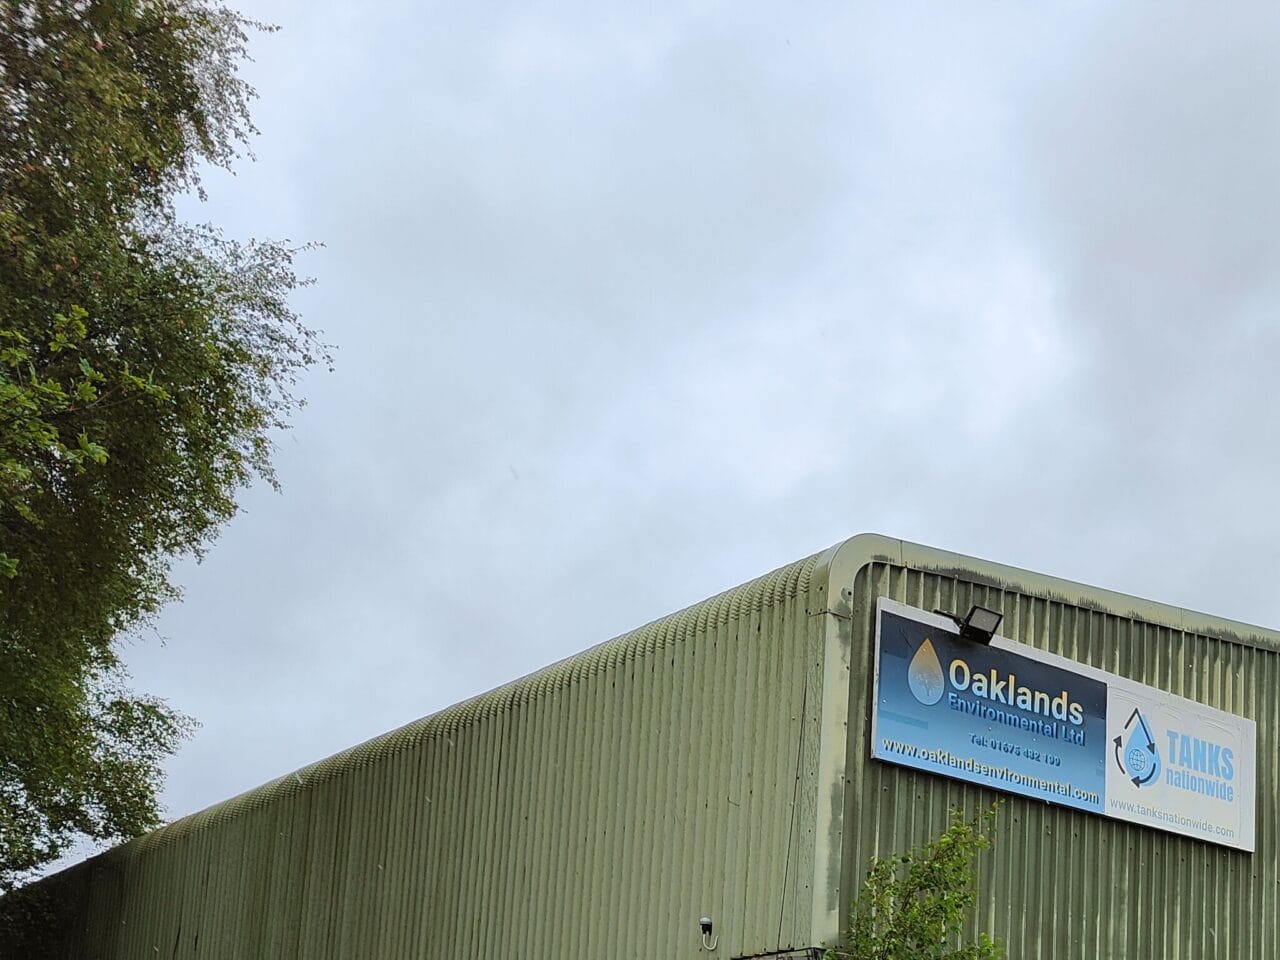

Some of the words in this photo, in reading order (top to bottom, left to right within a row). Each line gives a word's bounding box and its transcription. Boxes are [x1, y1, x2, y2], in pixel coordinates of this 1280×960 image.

[949, 659, 1084, 726] Oaklands
[948, 693, 1058, 739] Environmental
[1062, 725, 1085, 747] Ltd
[881, 738, 1099, 805] www.oaklandsenvironmental.com
[1166, 730, 1234, 781] TANKS
[1166, 768, 1233, 803] nationwide
[1110, 798, 1235, 839] www.tanksnationwide.com
